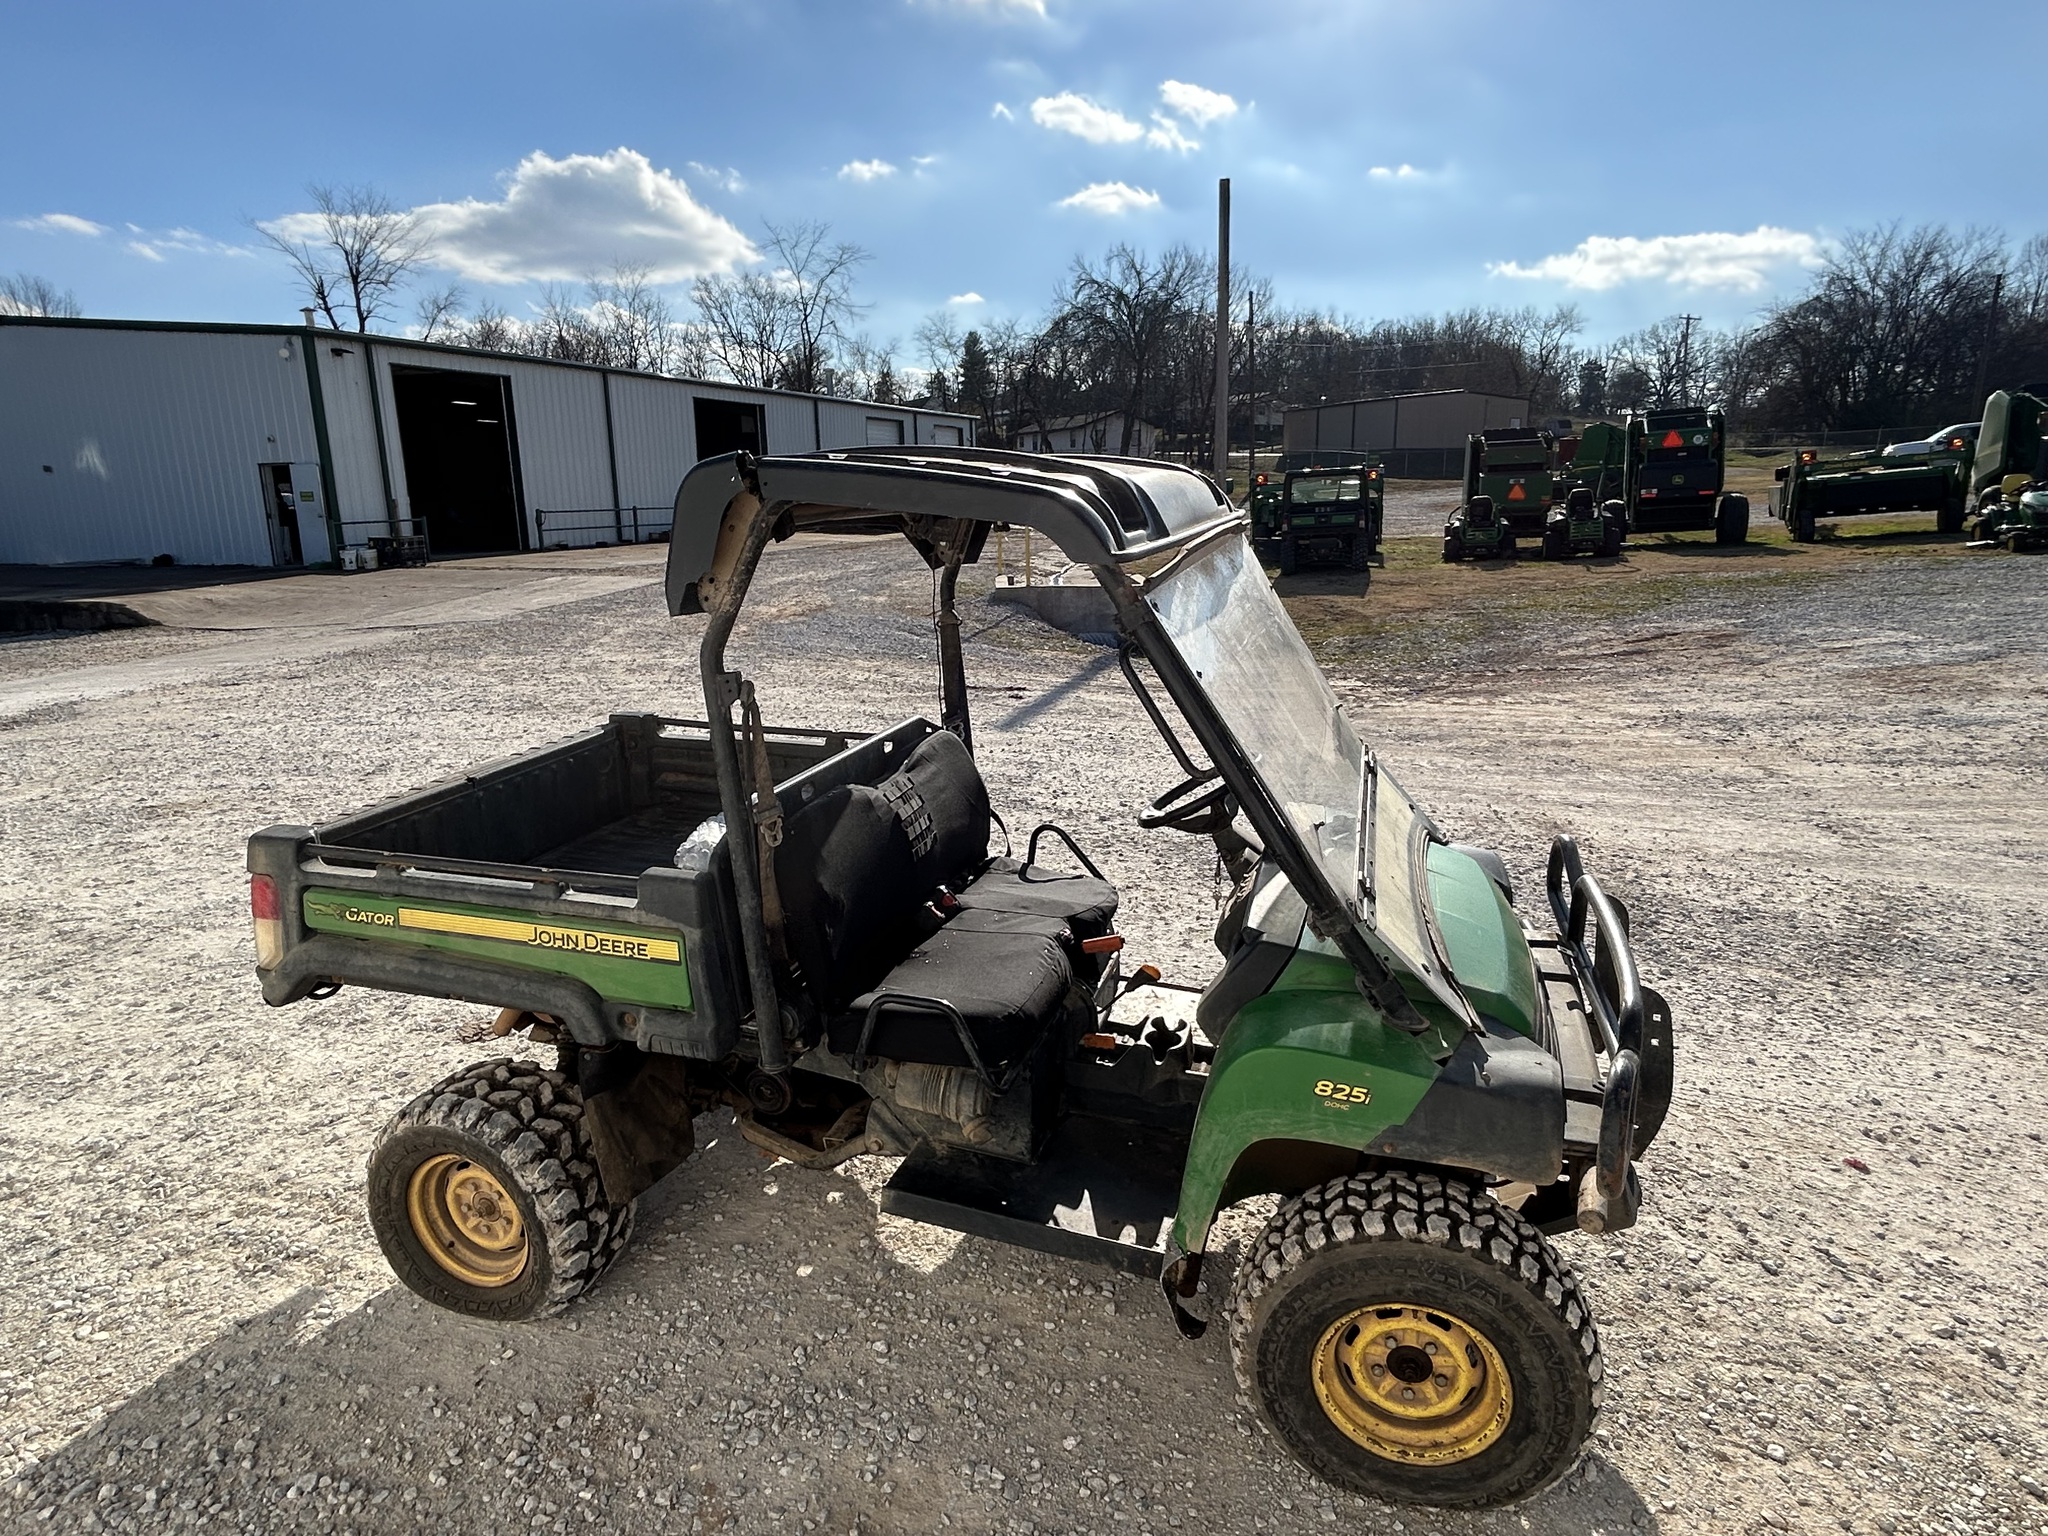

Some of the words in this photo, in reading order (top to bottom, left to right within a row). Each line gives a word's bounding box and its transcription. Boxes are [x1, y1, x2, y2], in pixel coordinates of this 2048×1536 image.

[345, 907, 395, 926] GATOR
[528, 927, 579, 948] JOHN
[584, 933, 648, 957] DEERE
[1314, 1080, 1372, 1105] 825i
